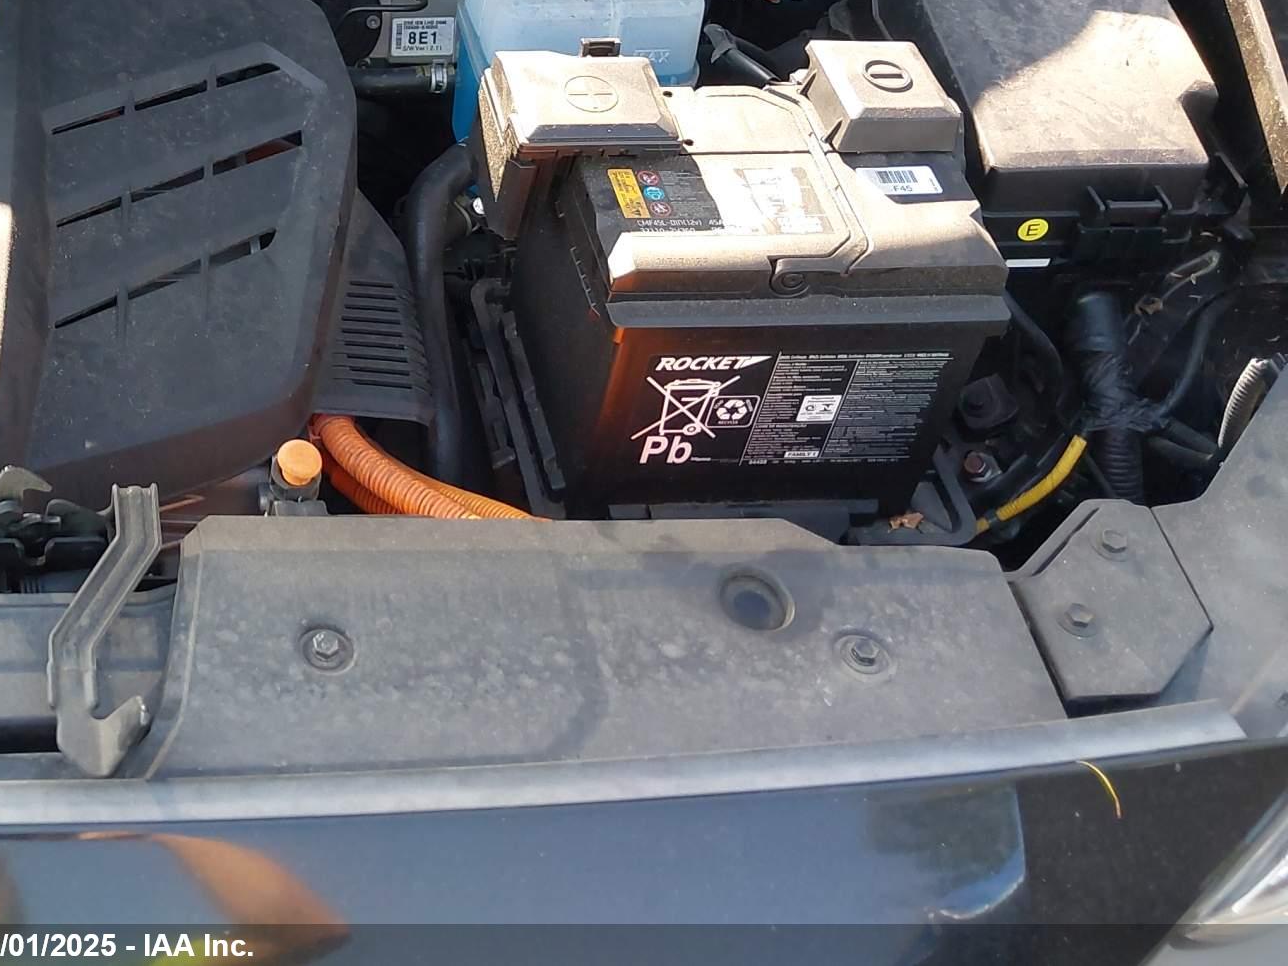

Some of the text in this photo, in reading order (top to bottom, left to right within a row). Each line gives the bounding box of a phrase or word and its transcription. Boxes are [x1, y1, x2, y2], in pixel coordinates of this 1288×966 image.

[408, 31, 437, 45] 8E1
[893, 185, 913, 193] F45
[1025, 224, 1041, 238] E
[655, 356, 770, 371] ROCKET
[639, 436, 693, 464] Pb
